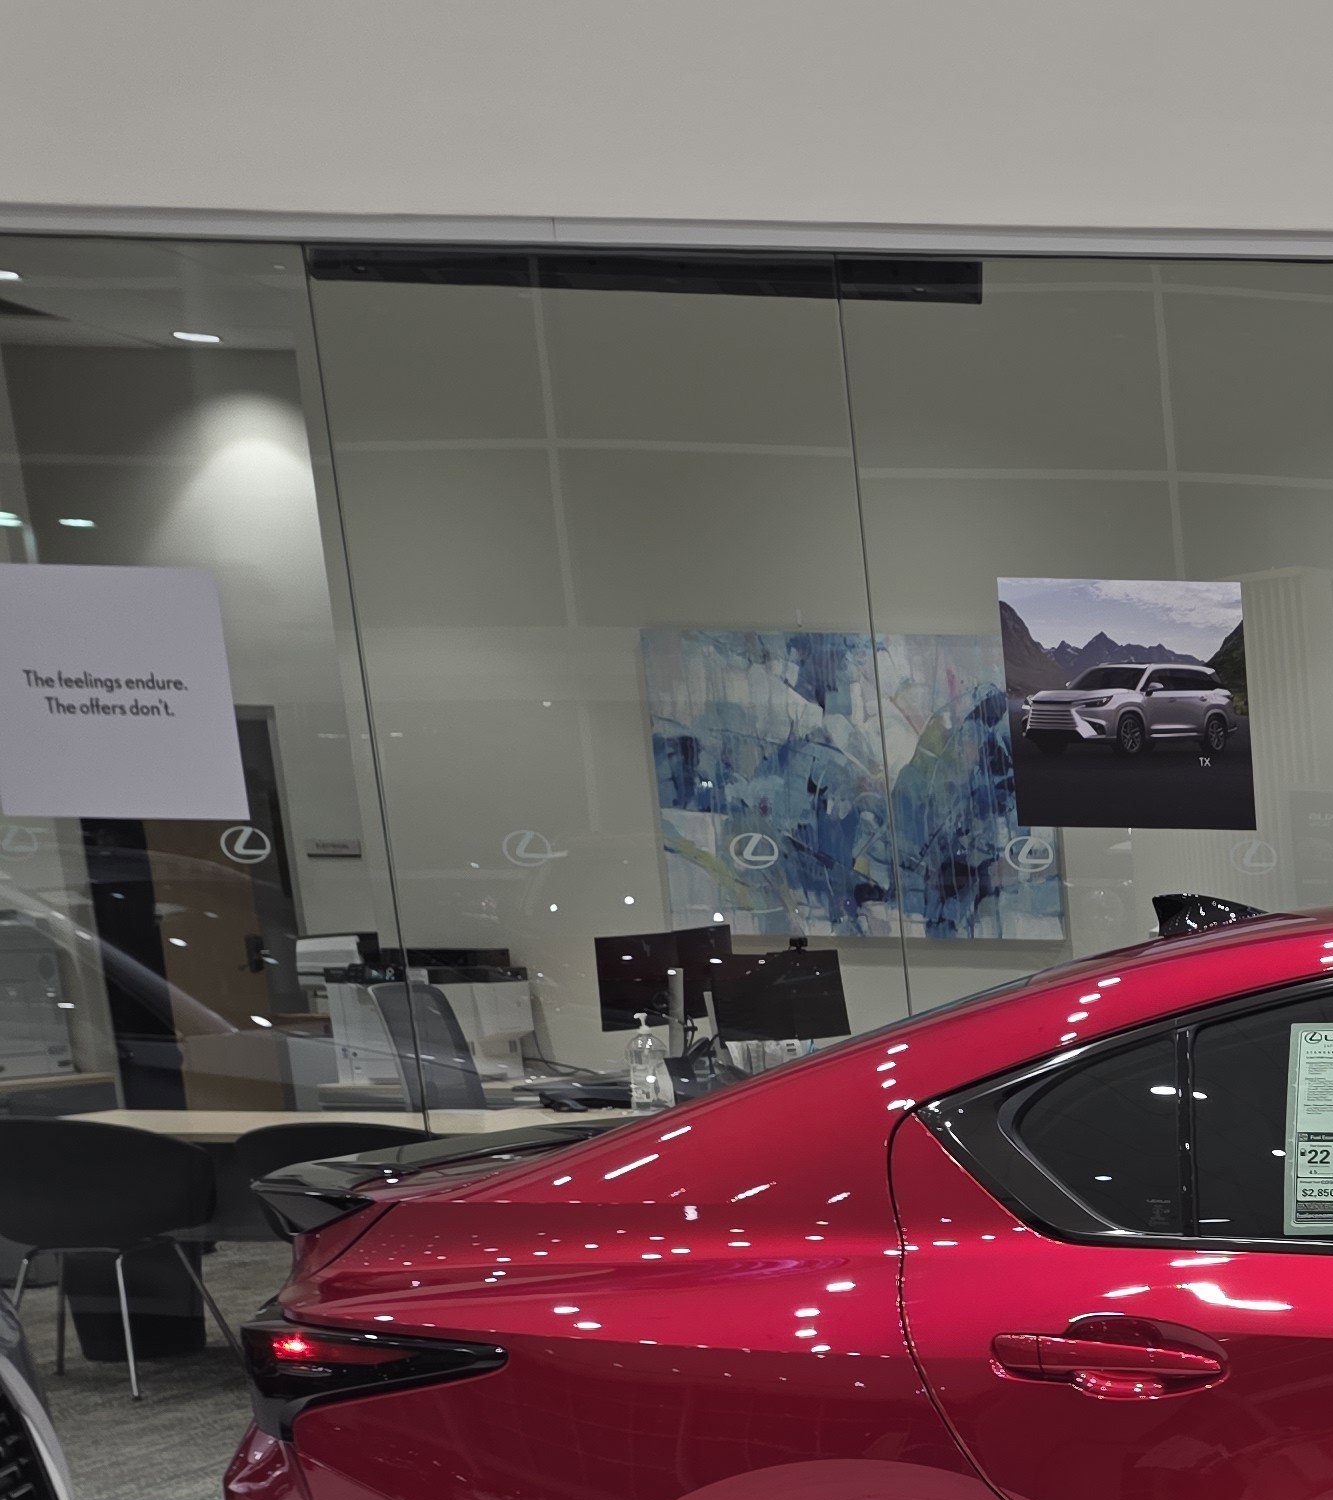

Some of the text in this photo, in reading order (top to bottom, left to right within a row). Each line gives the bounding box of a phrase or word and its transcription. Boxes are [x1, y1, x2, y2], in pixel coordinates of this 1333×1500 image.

[22, 669, 188, 693] The feelings endure.
[45, 696, 175, 717] The offers don't.
[1198, 757, 1211, 767] TX
[1307, 1149, 1331, 1165] 22
